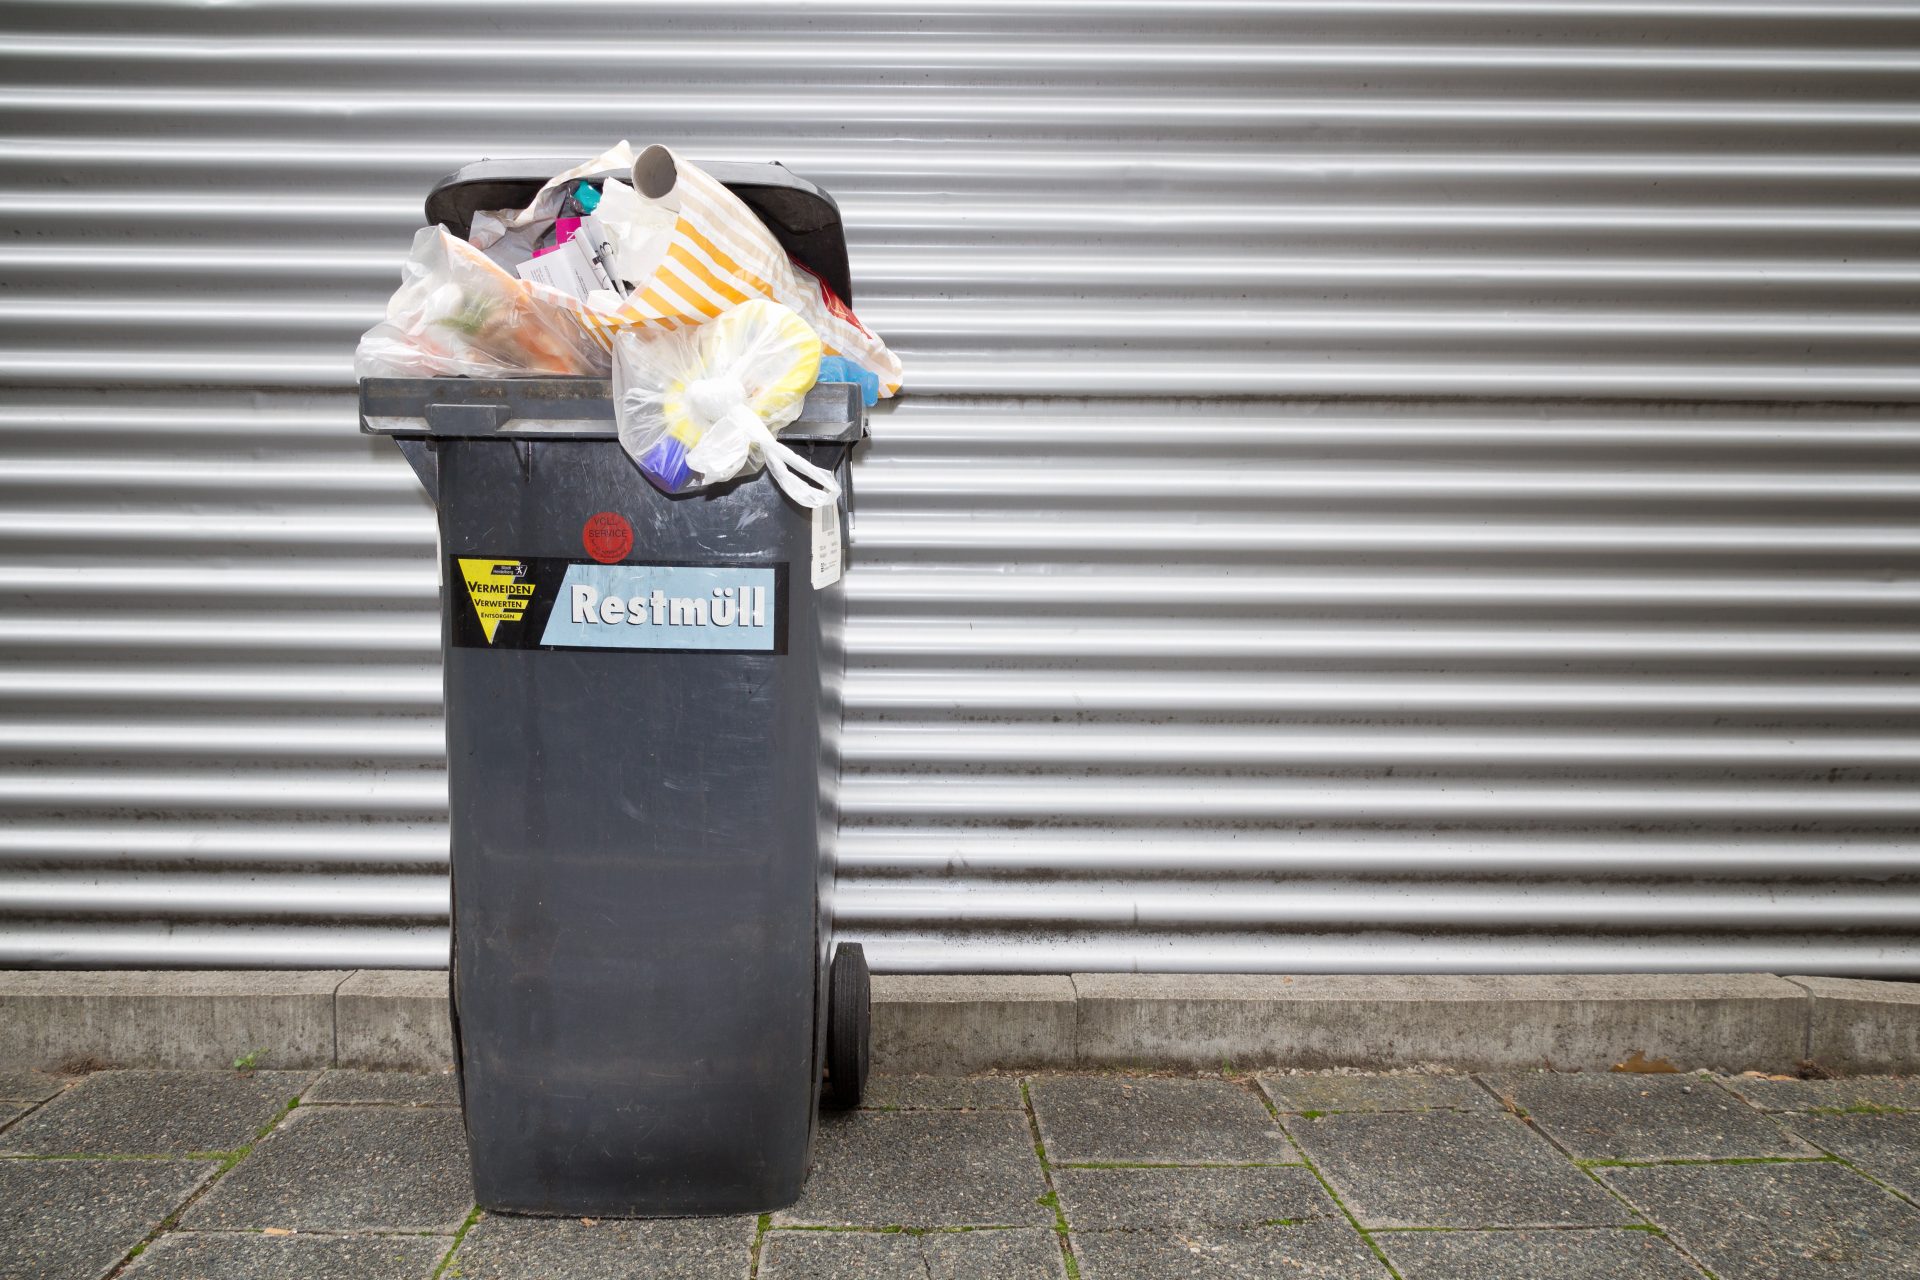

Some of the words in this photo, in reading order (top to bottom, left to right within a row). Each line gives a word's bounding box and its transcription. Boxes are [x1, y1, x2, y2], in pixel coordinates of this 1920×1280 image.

[589, 529, 628, 538] SERVICE
[468, 581, 531, 594] VERMEIDEN
[474, 599, 522, 608] VERWERTEN
[571, 585, 765, 627] Restmüll
